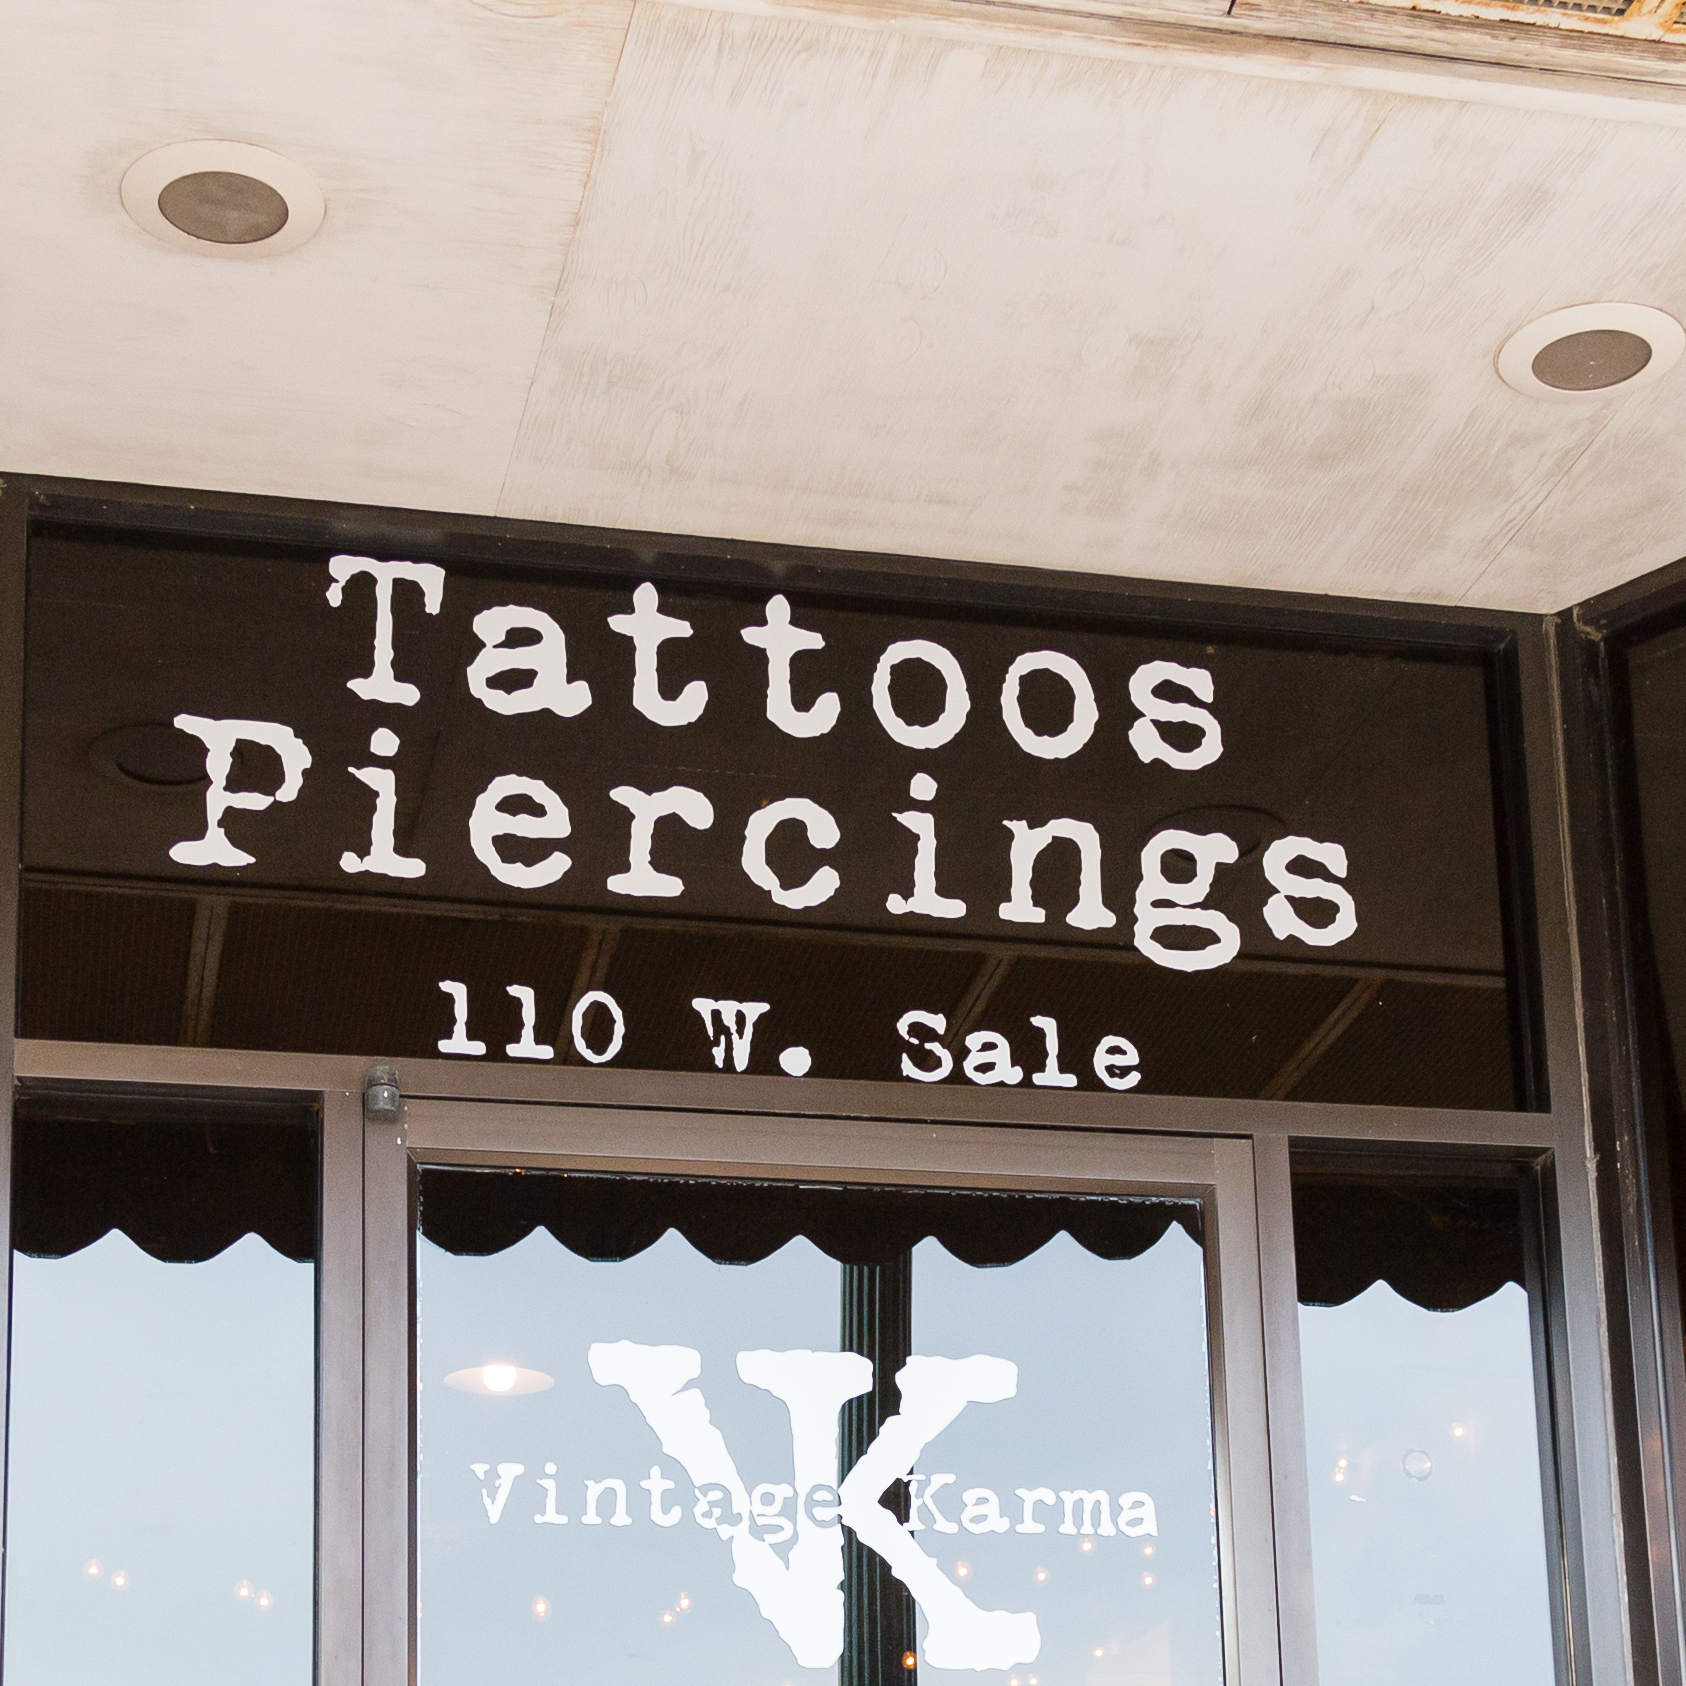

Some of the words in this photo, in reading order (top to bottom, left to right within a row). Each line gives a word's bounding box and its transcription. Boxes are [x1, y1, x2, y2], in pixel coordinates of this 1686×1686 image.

[325, 554, 1224, 770] Tattoos
[169, 713, 1358, 971] Piercings
[438, 980, 626, 1063] 110
[692, 999, 812, 1076] W.
[896, 1010, 1142, 1090] Sale
[470, 1462, 843, 1546] Vintage
[904, 1473, 1159, 1537] Karma
